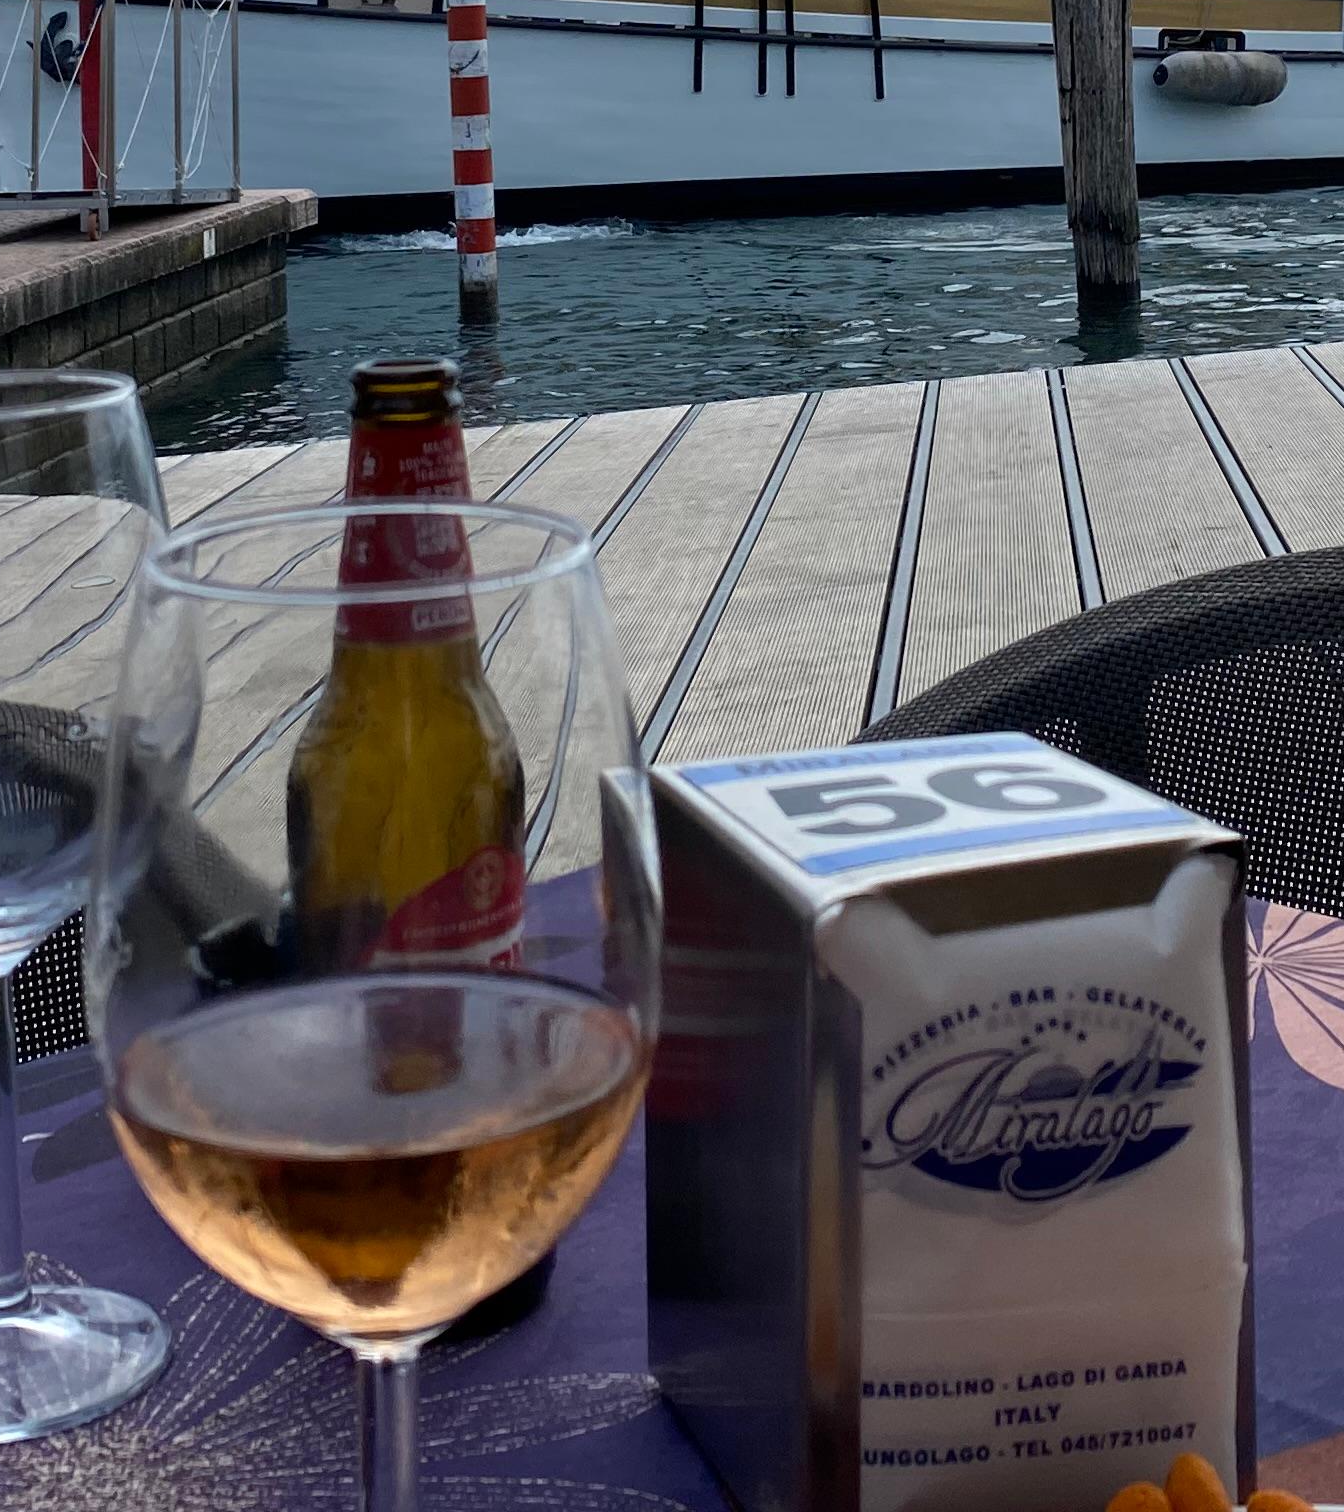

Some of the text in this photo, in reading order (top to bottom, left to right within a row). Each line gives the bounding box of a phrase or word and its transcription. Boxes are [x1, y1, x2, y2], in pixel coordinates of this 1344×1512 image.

[766, 763, 1108, 836] 56
[872, 986, 1207, 1082] PIZZERIA BAR GELATERIA
[858, 1044, 1163, 1202] Miralago
[862, 1377, 995, 1399] BARDOLINO
[1016, 1368, 1076, 1392] LAGO
[1084, 1367, 1106, 1386] DI
[1114, 1359, 1188, 1382] GARDA
[994, 1402, 1062, 1427] ITALY
[861, 1445, 991, 1467] UNGOLAGO
[1012, 1439, 1053, 1459] TEL
